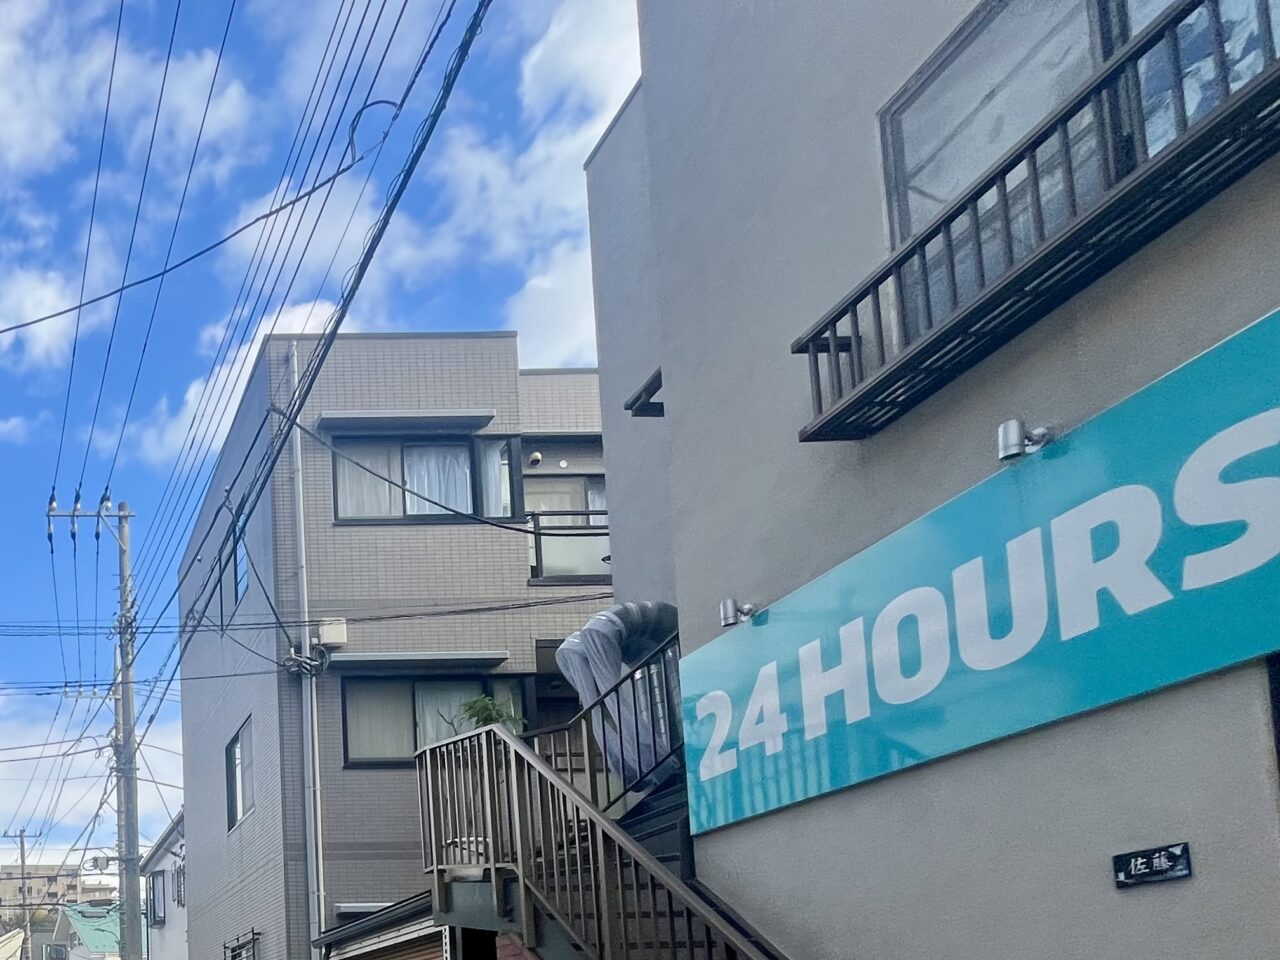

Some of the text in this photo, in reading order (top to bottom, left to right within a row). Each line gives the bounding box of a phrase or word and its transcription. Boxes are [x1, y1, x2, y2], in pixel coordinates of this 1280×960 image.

[695, 407, 1280, 783] 24 HOURS
[1130, 851, 1174, 875] 佐藤
